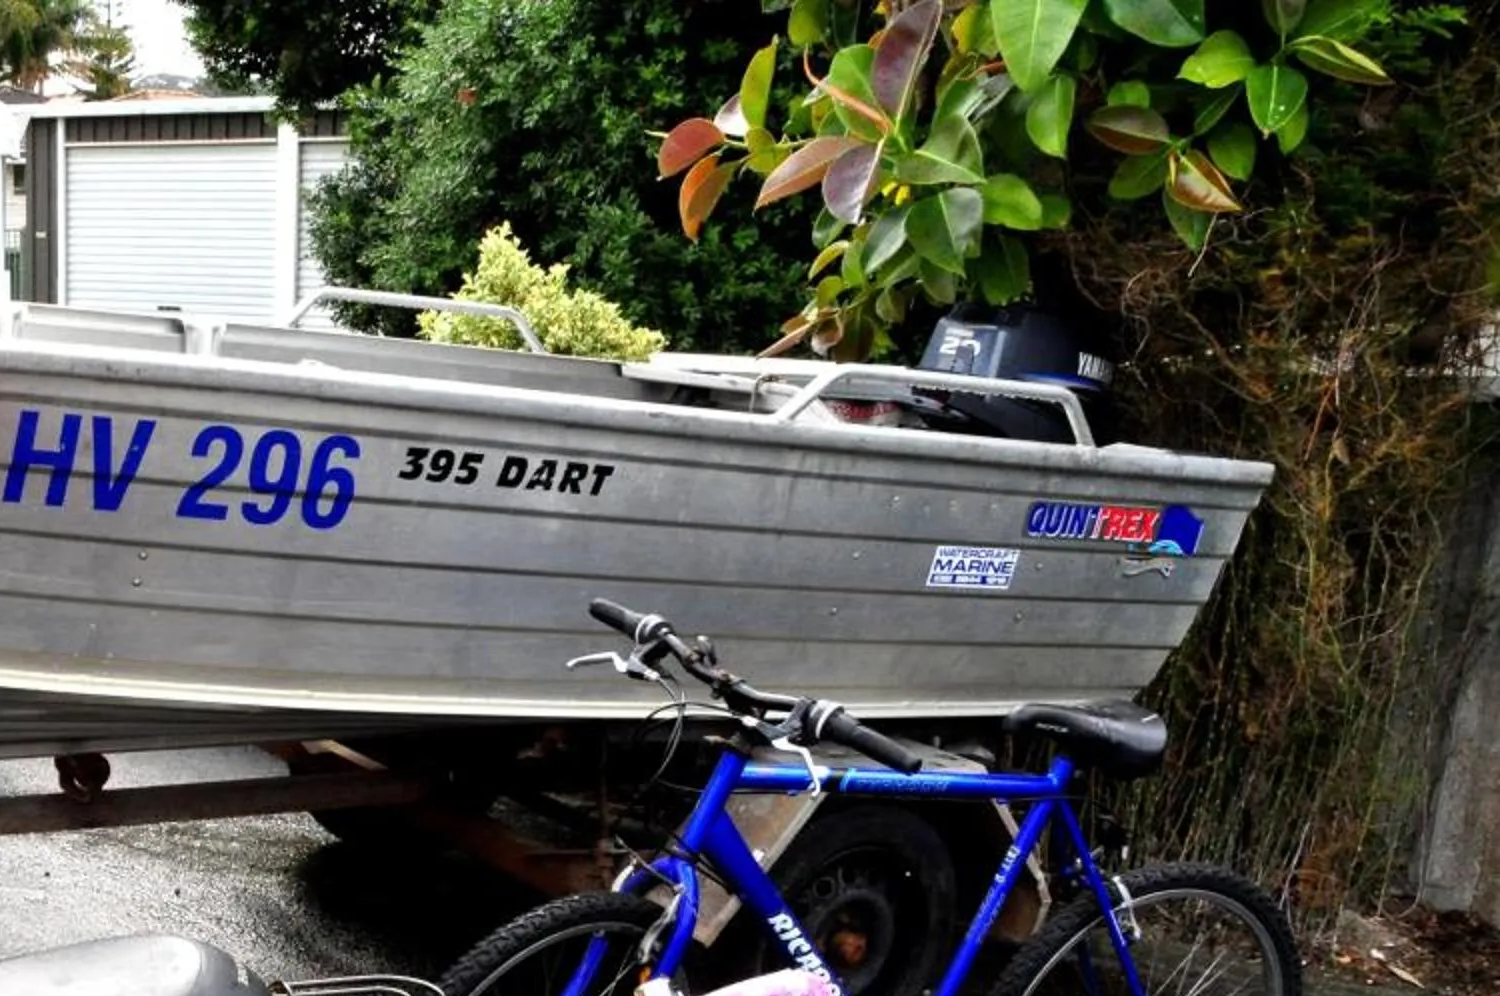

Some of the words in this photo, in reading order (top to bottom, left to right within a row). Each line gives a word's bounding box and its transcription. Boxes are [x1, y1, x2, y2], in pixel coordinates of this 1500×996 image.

[2, 410, 155, 511] HV
[177, 425, 361, 529] 296
[399, 447, 483, 485] 395
[496, 456, 615, 497] DART
[1027, 504, 1161, 543] QUINTREX
[934, 559, 1014, 574] MARINE
